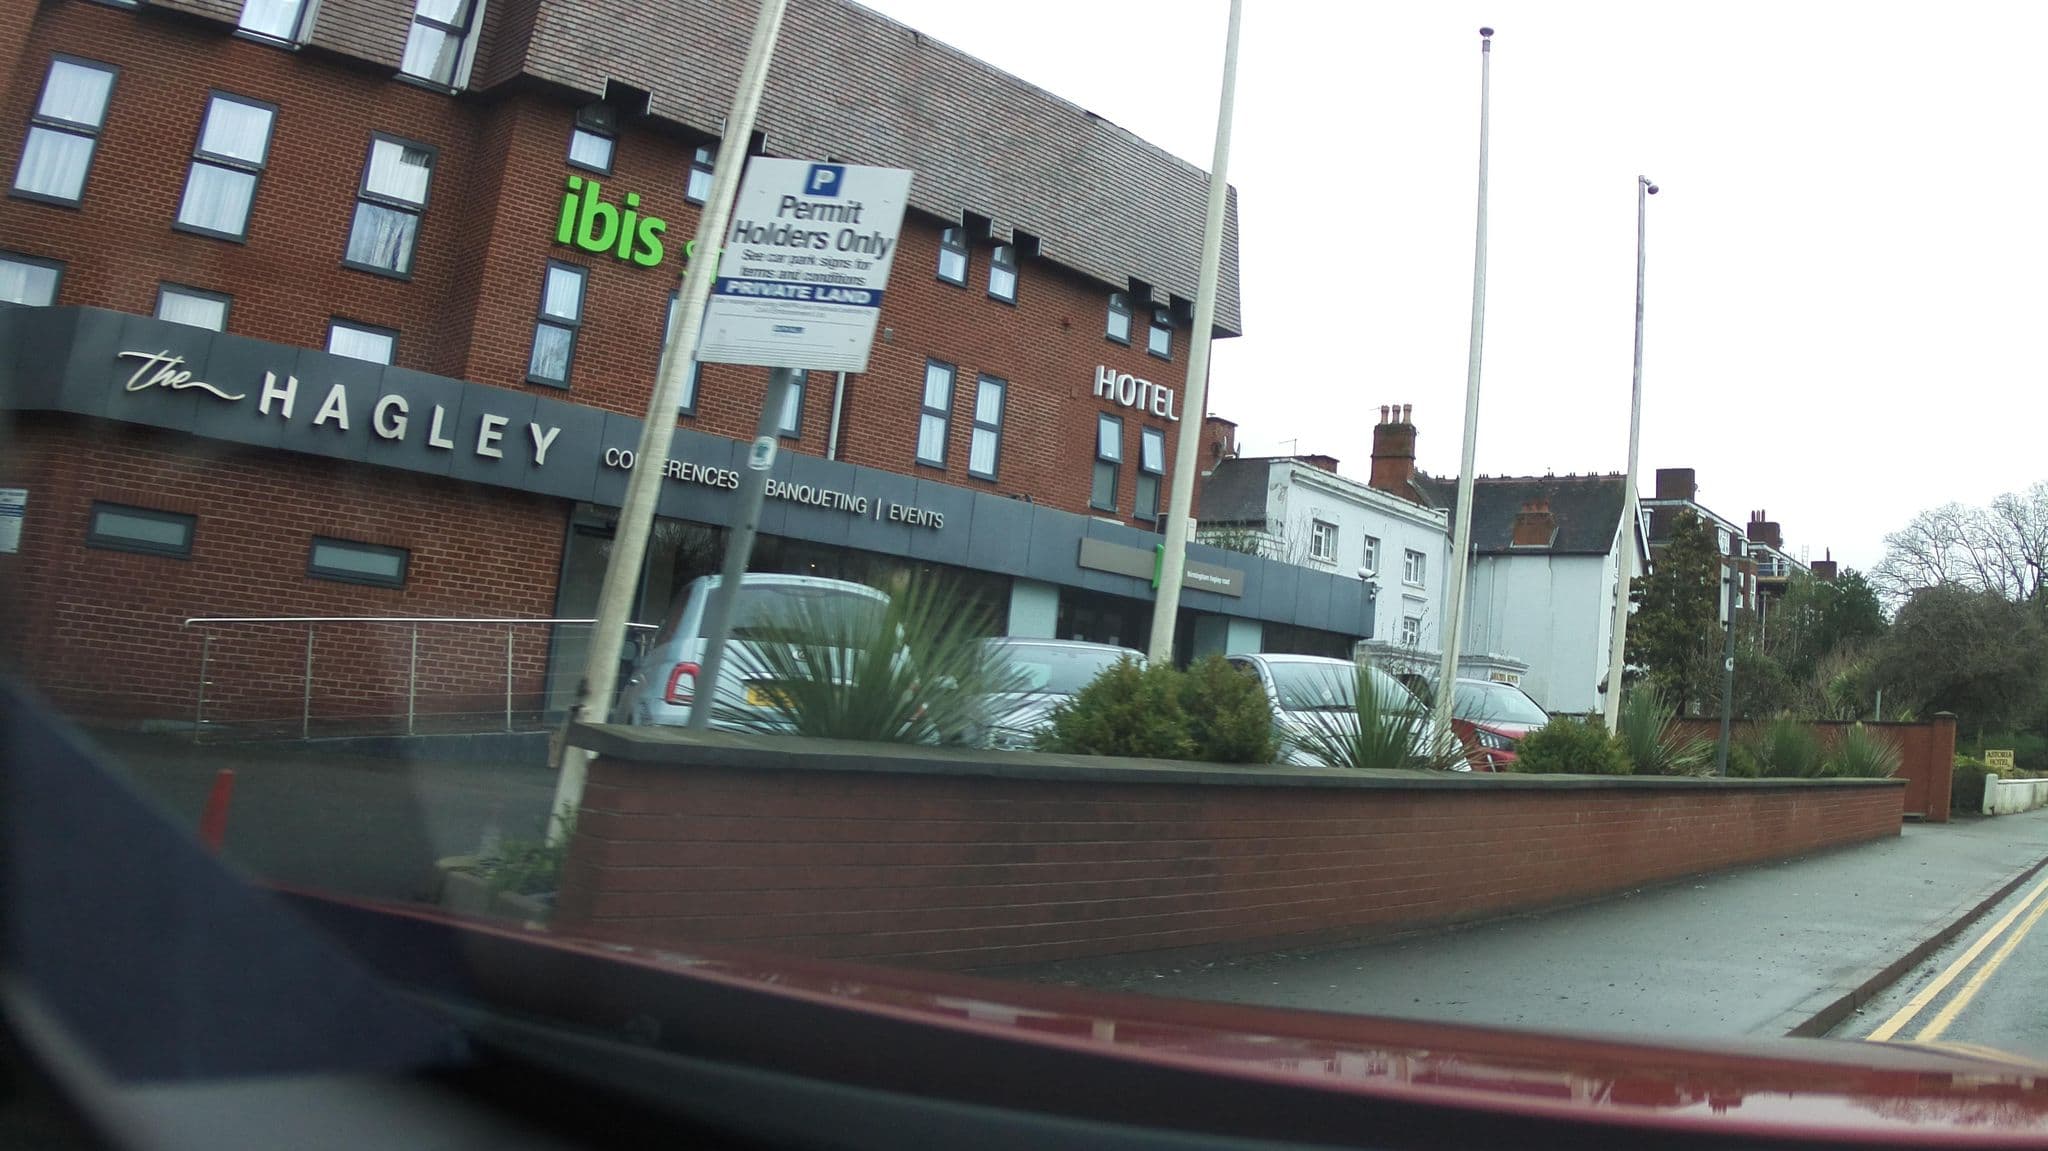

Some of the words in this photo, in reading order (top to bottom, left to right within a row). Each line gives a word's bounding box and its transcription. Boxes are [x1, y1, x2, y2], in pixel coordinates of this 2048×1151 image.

[811, 169, 836, 190] P
[557, 175, 667, 267] ibis
[777, 194, 864, 225] Permit
[732, 219, 830, 250] Holders
[836, 228, 895, 260] Only
[741, 249, 763, 262] See
[767, 253, 786, 264] car
[789, 254, 816, 267] park
[819, 256, 852, 270] signs
[741, 267, 775, 279] terms
[778, 269, 801, 282] and
[803, 271, 867, 286] conditions
[724, 279, 813, 300] PRIVATE
[814, 287, 872, 304] LAND
[1093, 365, 1180, 421] HOTEL
[258, 370, 562, 467] HAGLEY
[765, 478, 868, 514] BANQUETING
[889, 503, 945, 529] EVENTS
